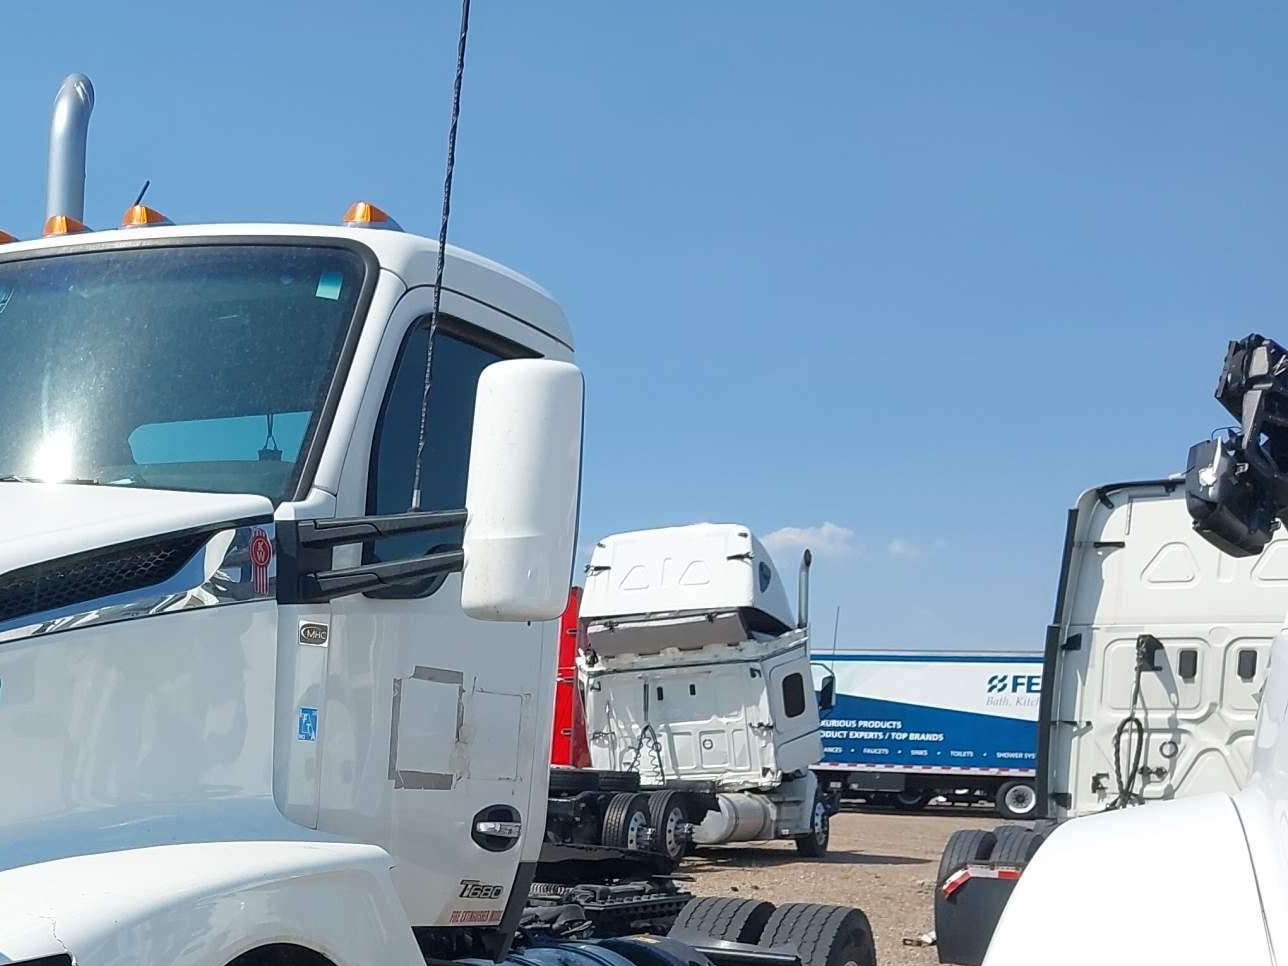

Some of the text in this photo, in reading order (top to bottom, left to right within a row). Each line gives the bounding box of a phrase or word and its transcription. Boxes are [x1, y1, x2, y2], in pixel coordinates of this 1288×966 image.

[306, 629, 327, 640] MHC
[858, 720, 902, 729] PRODUCTS
[849, 731, 883, 740] EXPERTS
[890, 732, 908, 740] TOP
[909, 733, 944, 742] BRANDS
[950, 750, 973, 758] TOILETS
[459, 880, 504, 899] T680
